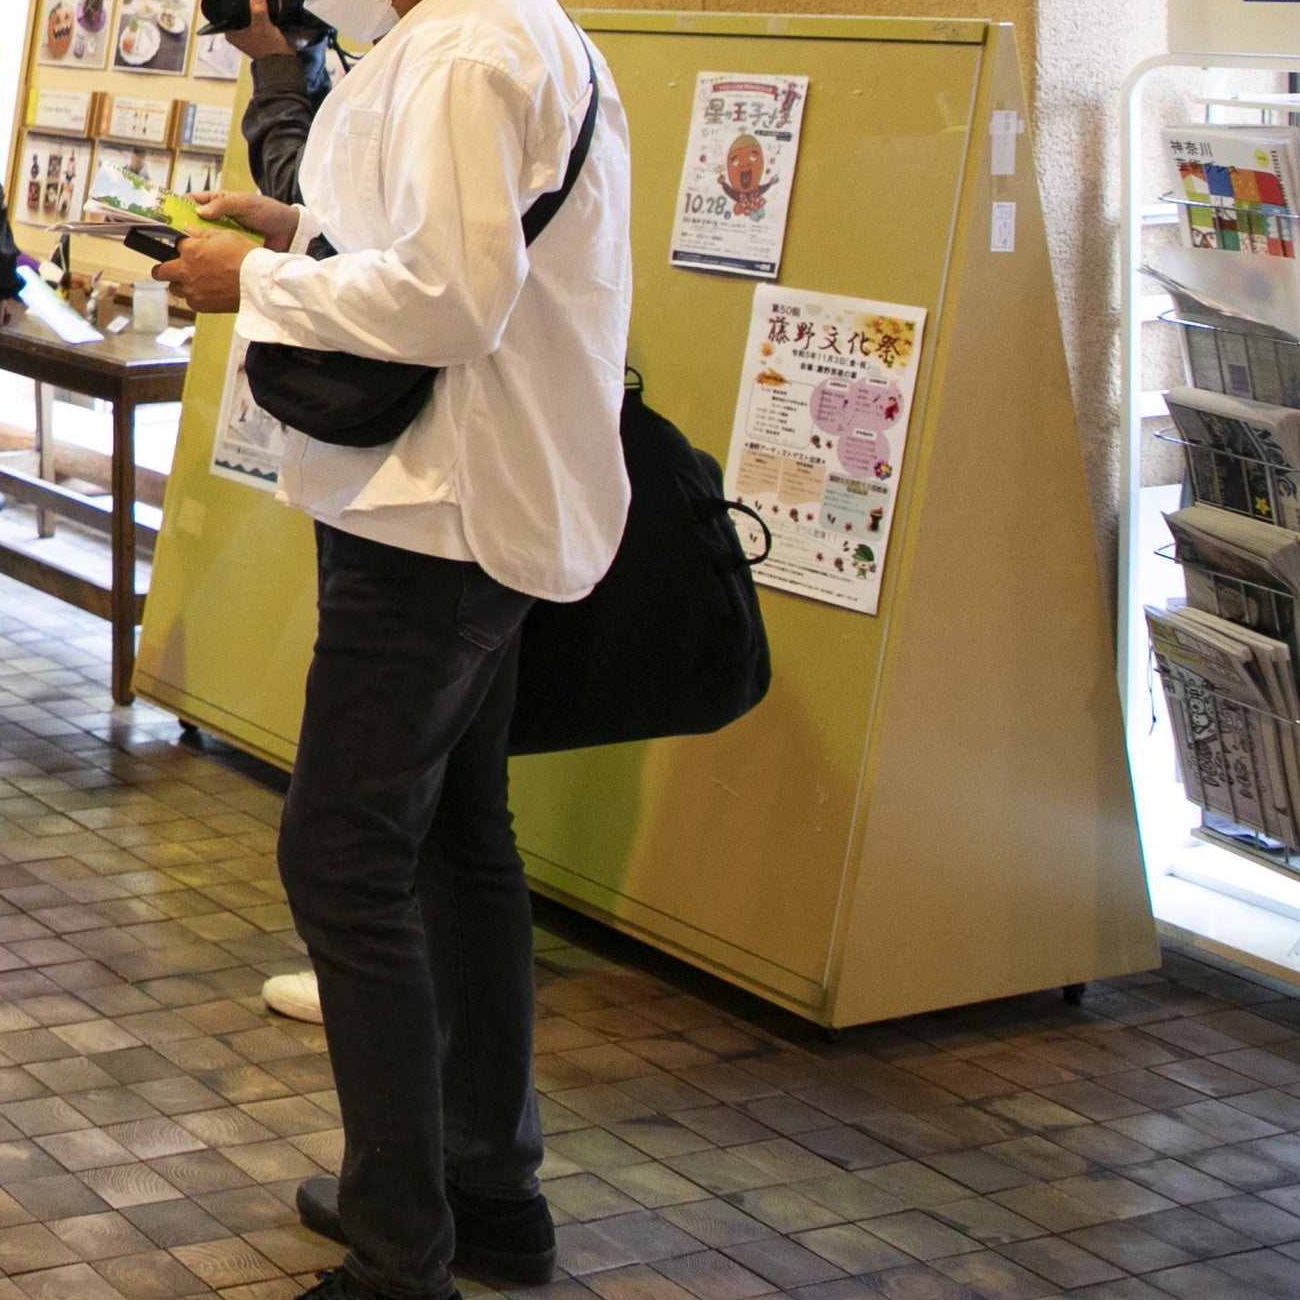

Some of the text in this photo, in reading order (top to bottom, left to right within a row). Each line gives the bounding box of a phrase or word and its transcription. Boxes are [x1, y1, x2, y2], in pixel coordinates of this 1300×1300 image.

[1169, 139, 1213, 158] 神奈川
[767, 315, 902, 363] 藤野文化祭
